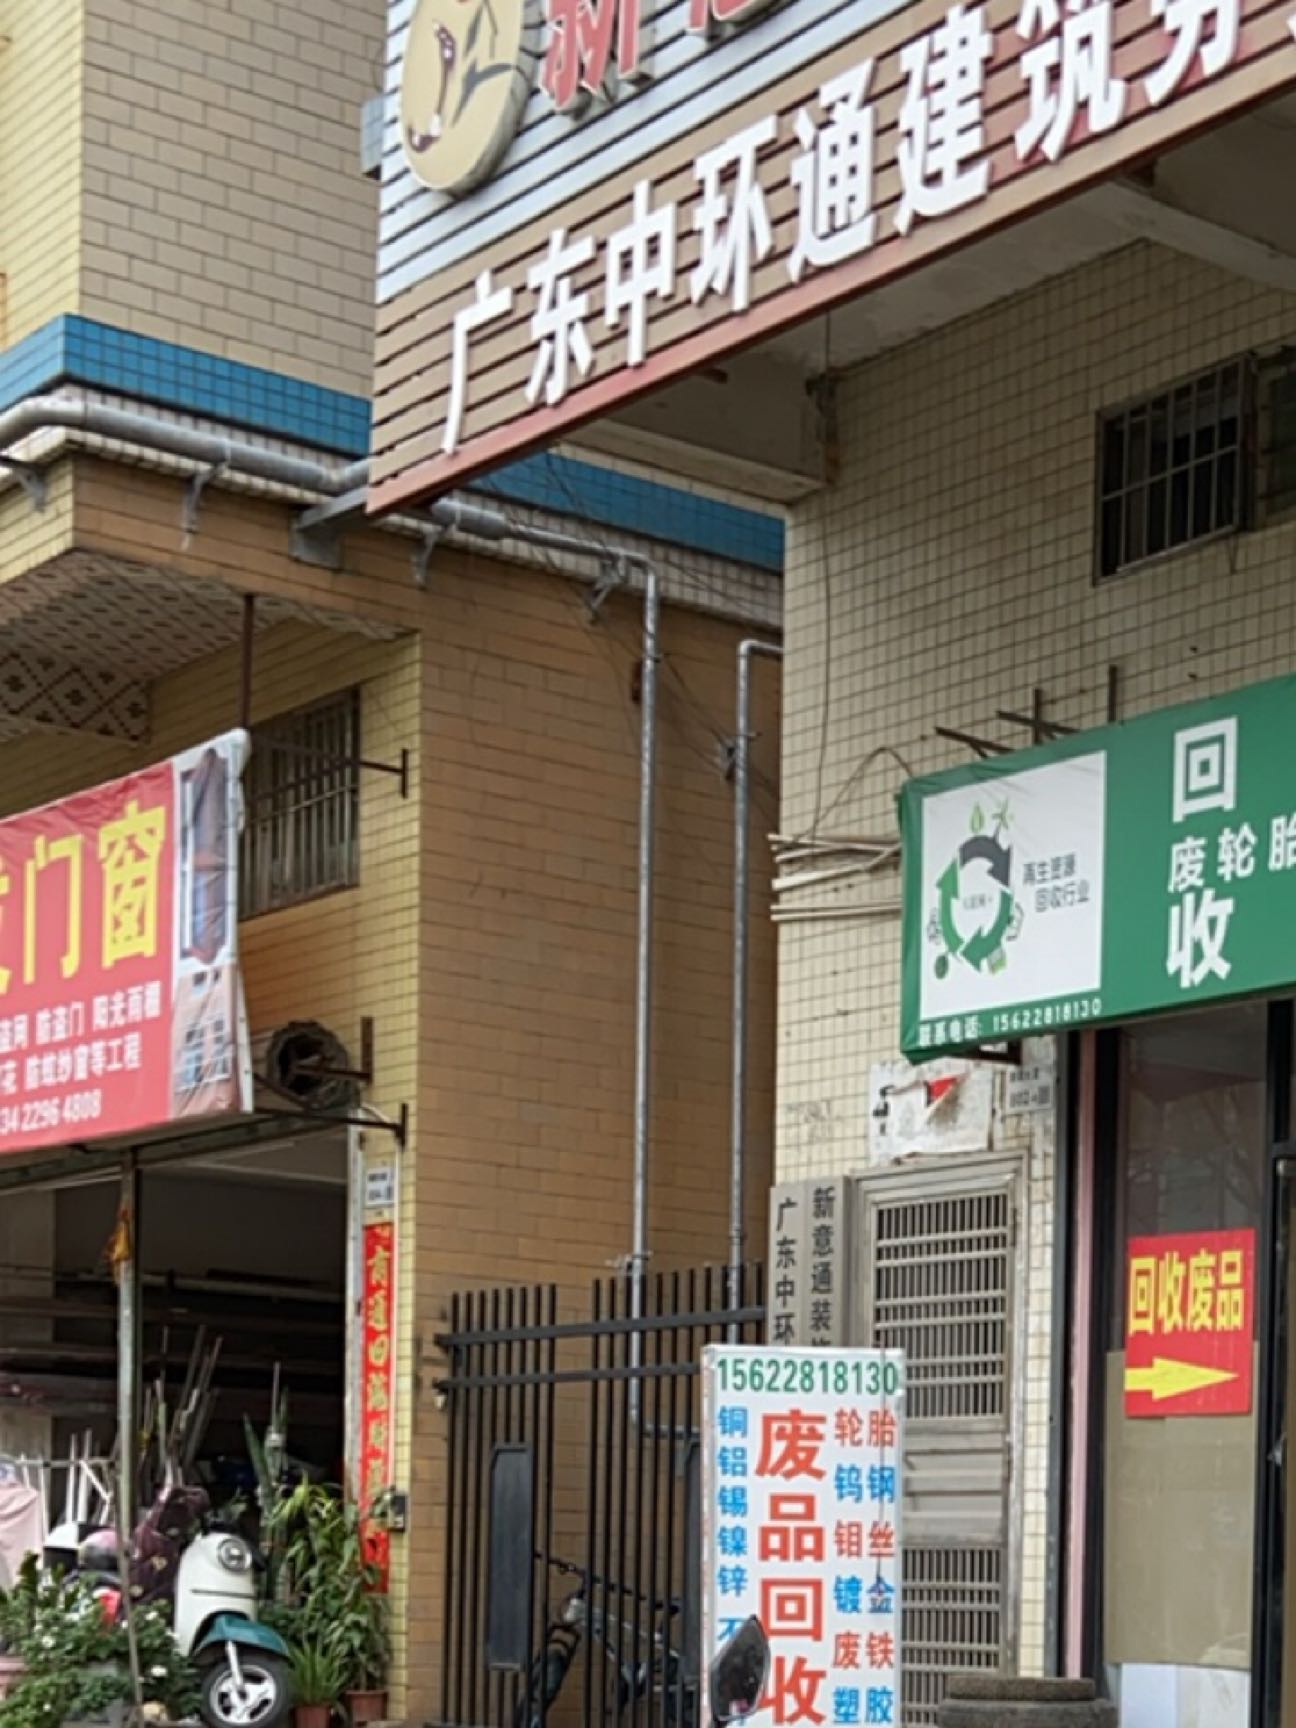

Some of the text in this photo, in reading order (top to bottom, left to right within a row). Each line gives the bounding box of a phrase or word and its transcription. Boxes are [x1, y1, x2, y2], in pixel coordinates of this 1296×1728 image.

[0, 800, 167, 996] 门窗
[993, 997, 1101, 1033] 15622818130
[1129, 1249, 1243, 1334] 回收废品
[717, 1358, 898, 1396] 15622818130
[834, 1407, 896, 1449] 轮胎
[755, 1409, 828, 1726] 废品回收
[832, 1631, 894, 1670] 废铁
[832, 1685, 894, 1725] 塑胶
